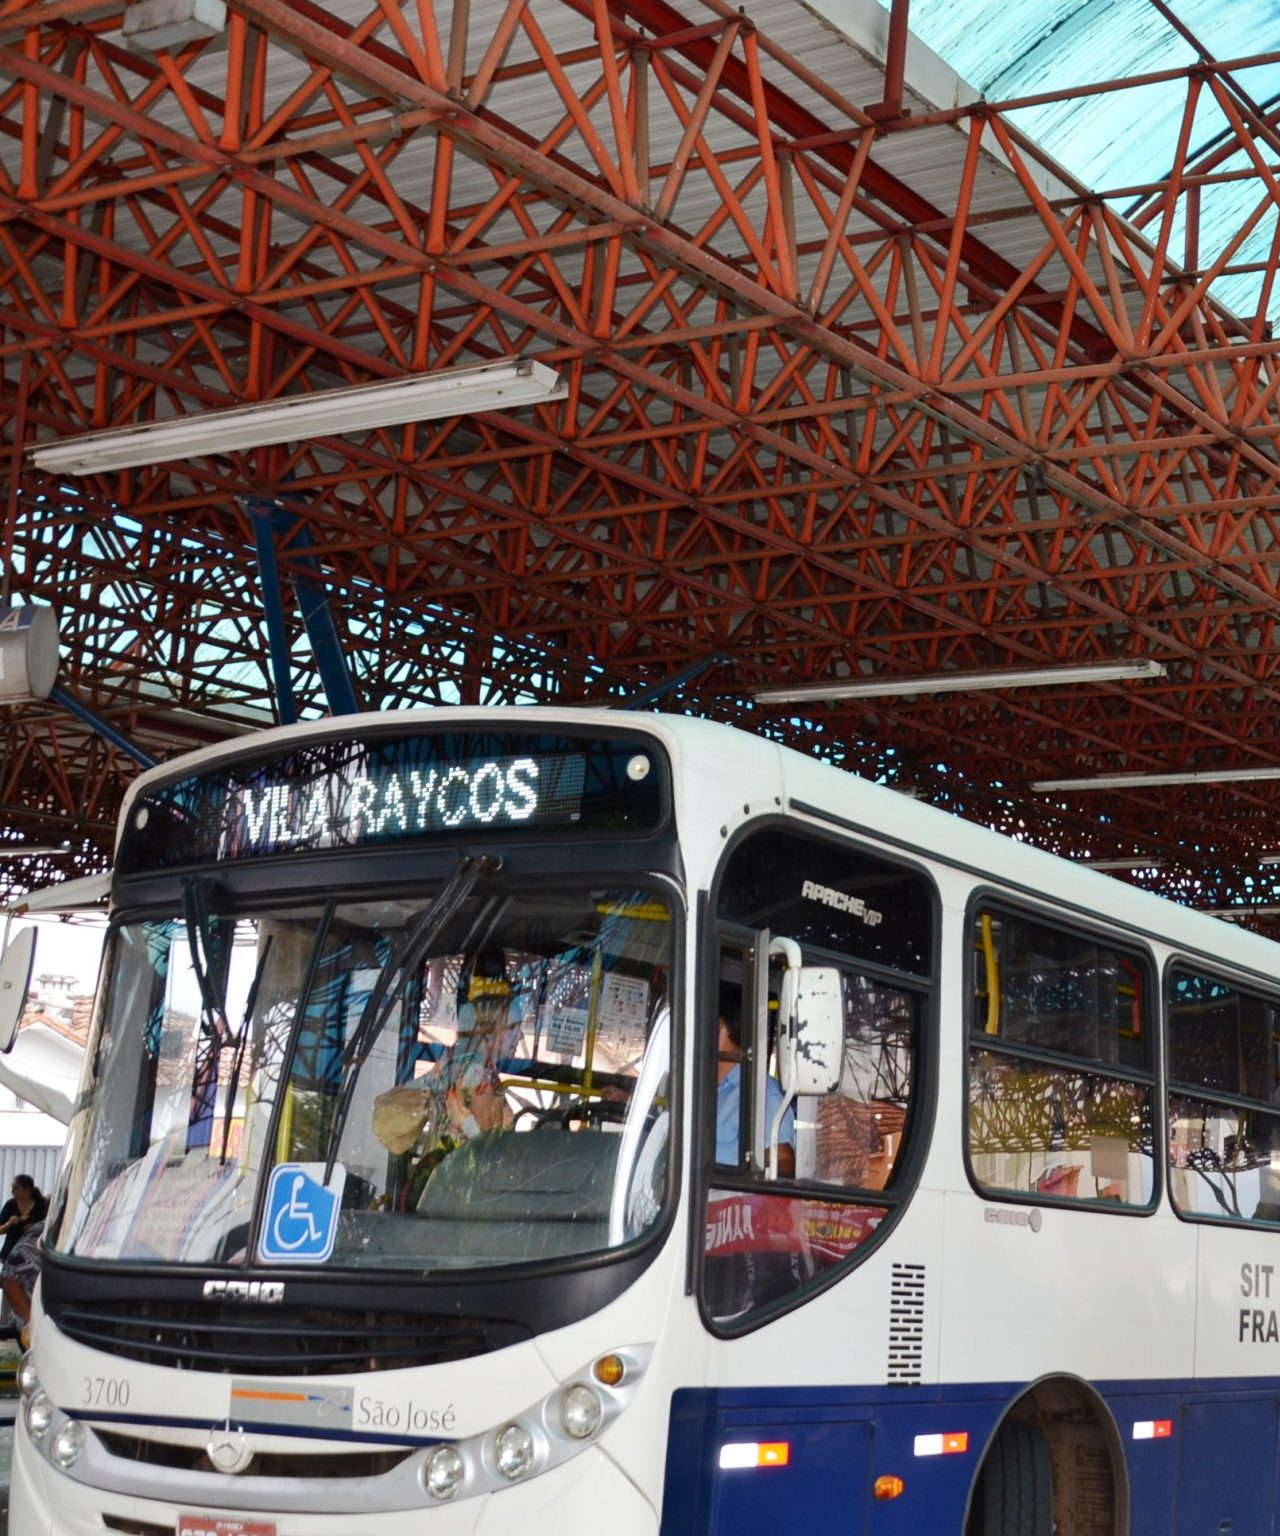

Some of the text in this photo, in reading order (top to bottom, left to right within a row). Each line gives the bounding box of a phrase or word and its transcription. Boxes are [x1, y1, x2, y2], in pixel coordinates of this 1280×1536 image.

[243, 758, 539, 844] VILA RAYCOS
[801, 879, 883, 928] APACHE VIP
[1240, 1262, 1274, 1298] SIT
[81, 1376, 131, 1407] 3700
[358, 1396, 456, 1432] São José
